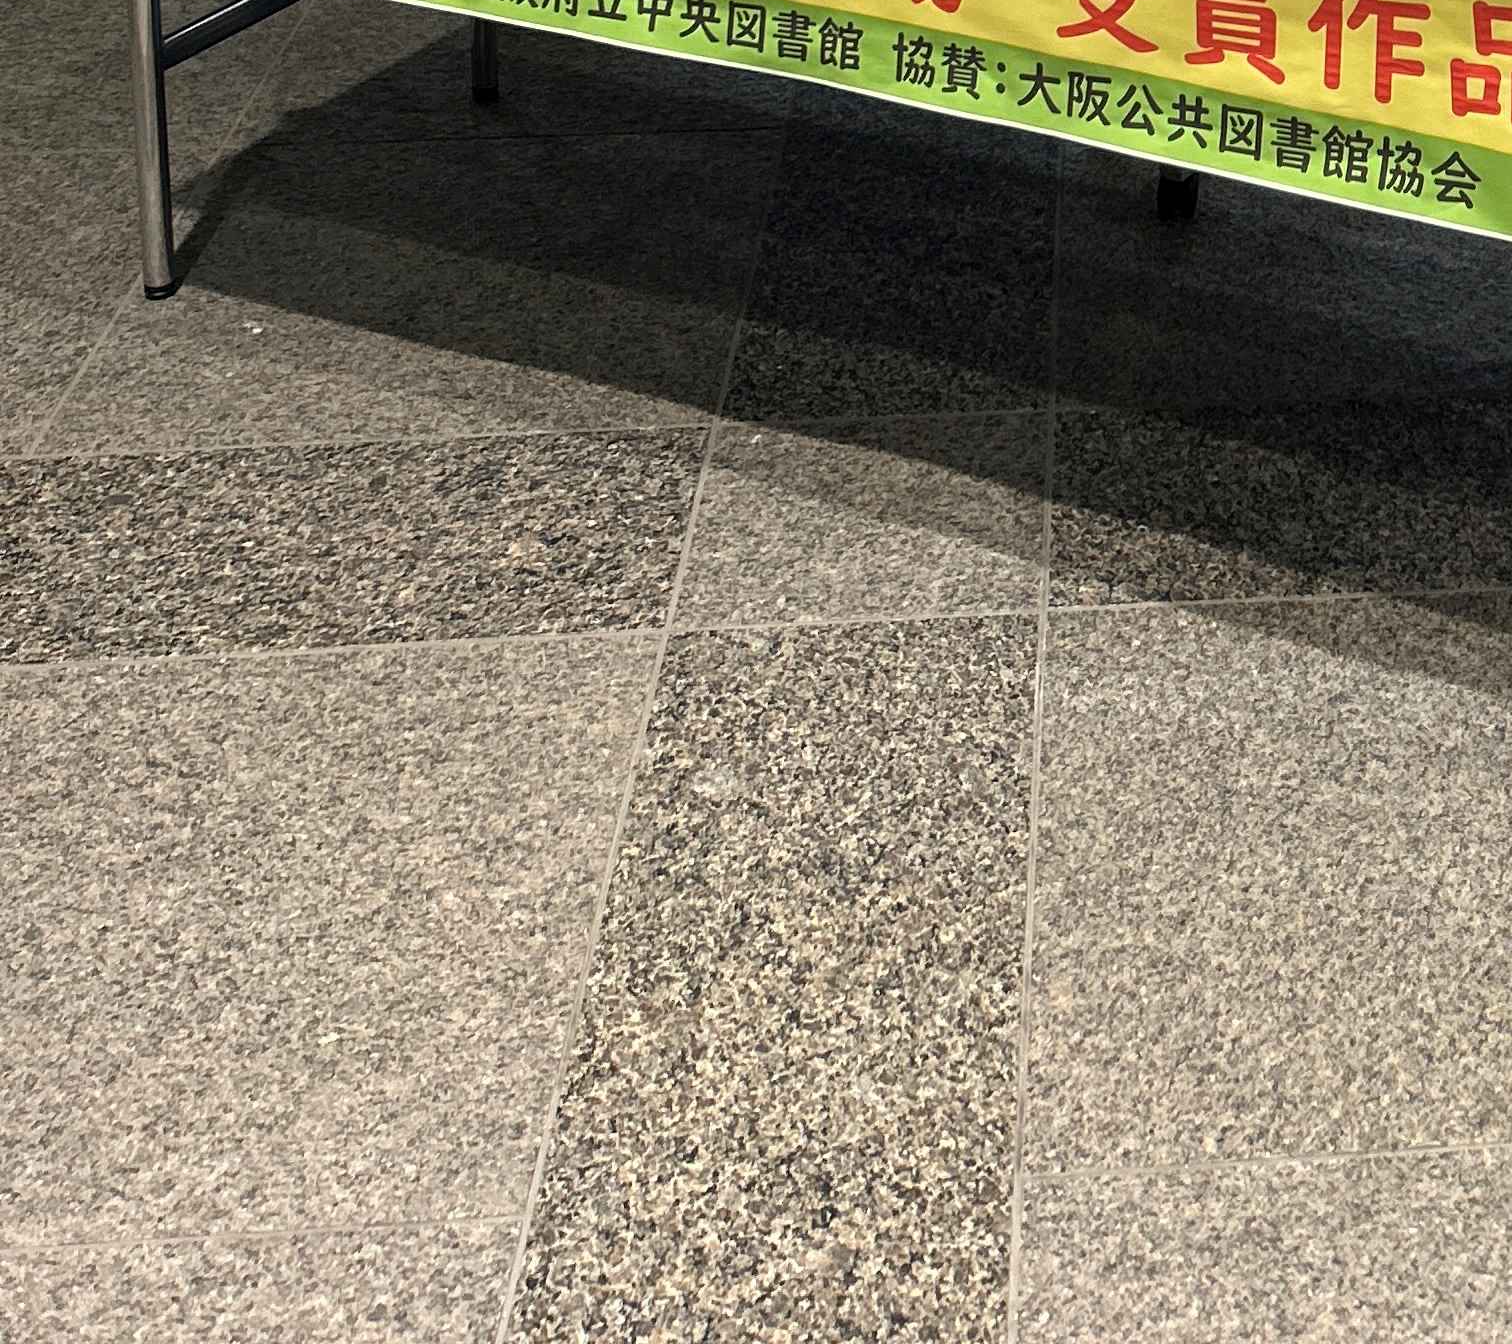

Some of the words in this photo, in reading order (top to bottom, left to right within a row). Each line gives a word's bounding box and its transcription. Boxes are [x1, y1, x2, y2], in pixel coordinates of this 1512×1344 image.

[892, 29, 1482, 210] 協賛：大阪公共図書館協会
